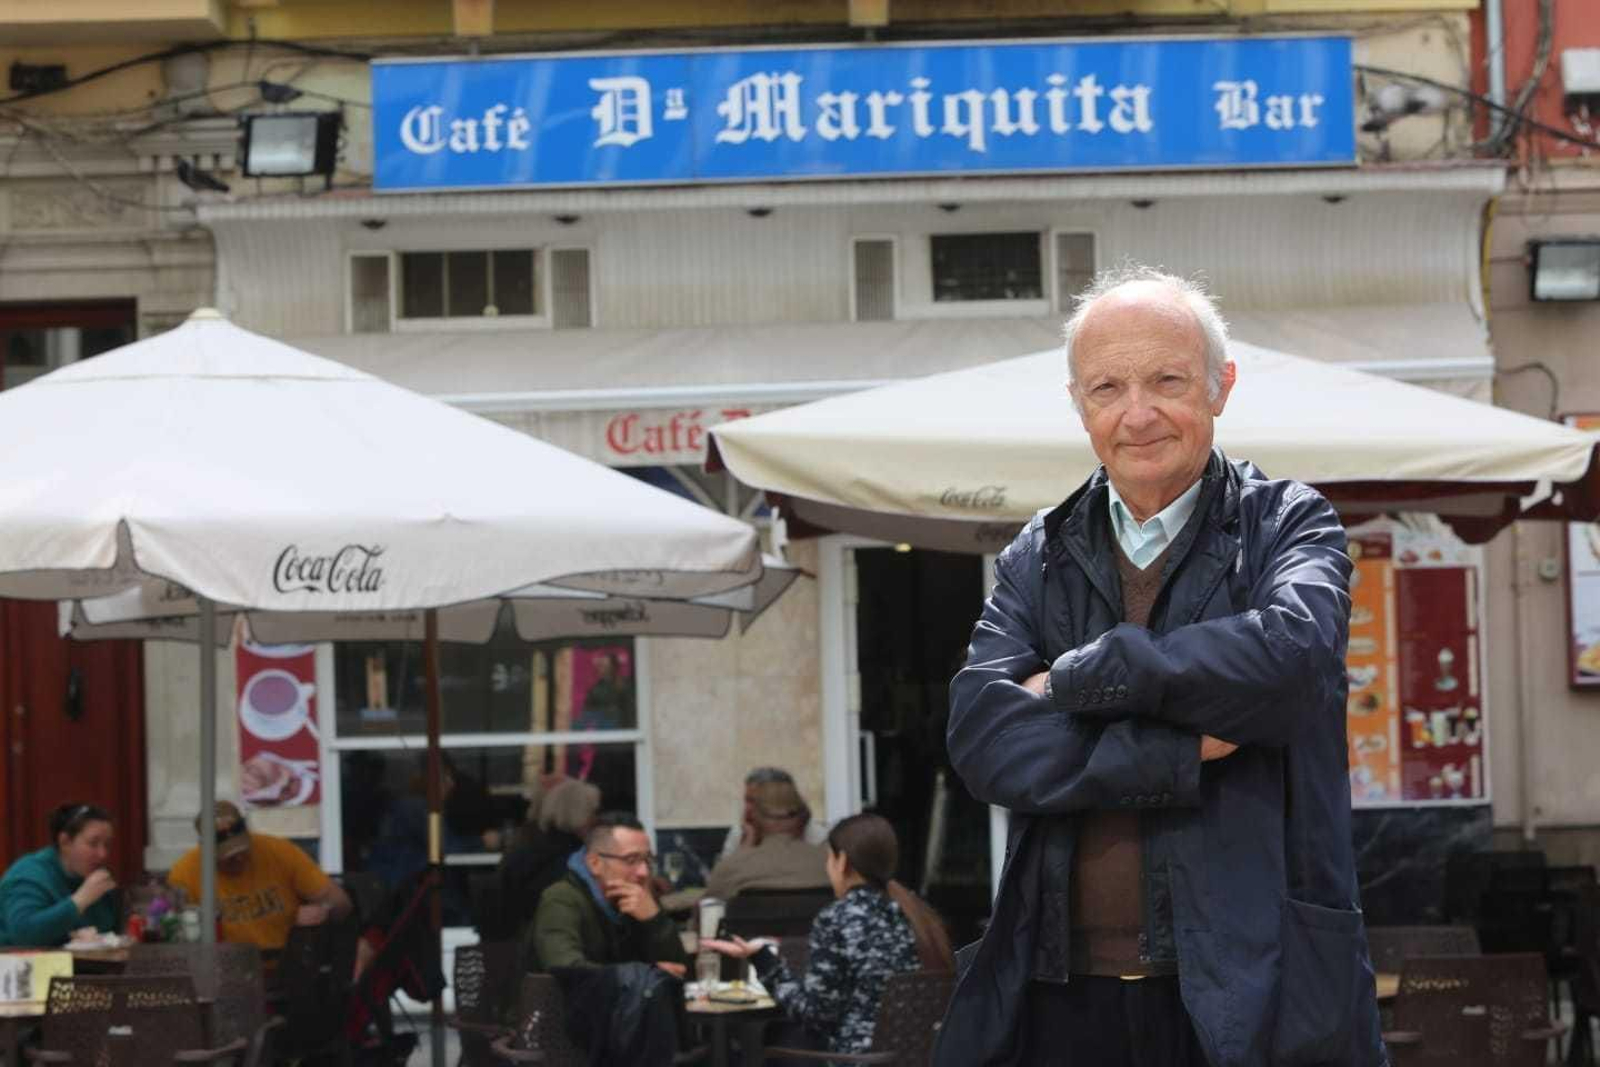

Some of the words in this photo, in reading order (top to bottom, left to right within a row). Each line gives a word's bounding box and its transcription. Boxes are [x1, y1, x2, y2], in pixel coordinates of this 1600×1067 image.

[400, 104, 530, 154] Café
[715, 72, 1153, 152] Mariquita
[1214, 80, 1324, 131] Bar
[606, 409, 703, 455] Café
